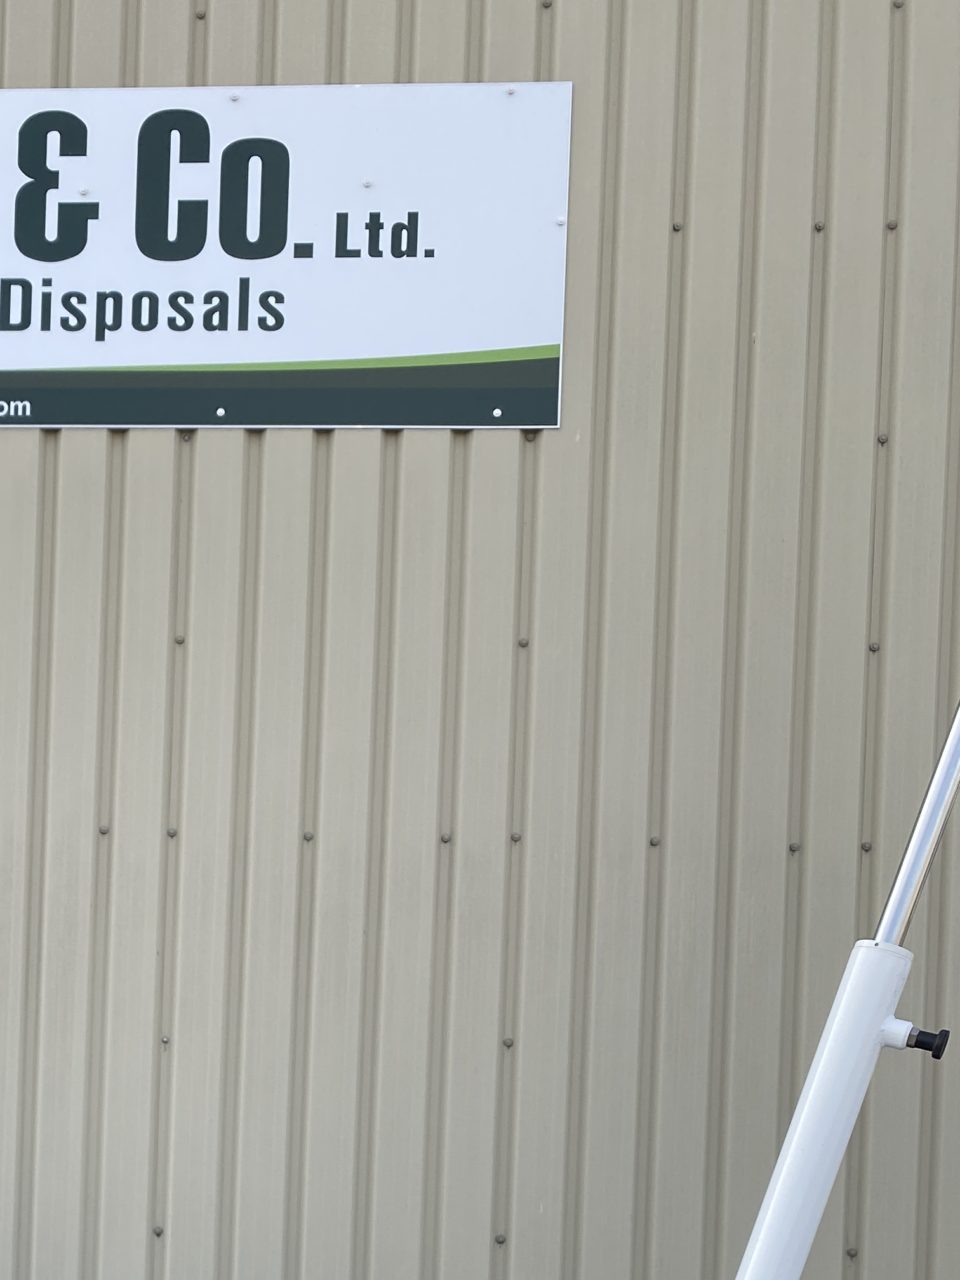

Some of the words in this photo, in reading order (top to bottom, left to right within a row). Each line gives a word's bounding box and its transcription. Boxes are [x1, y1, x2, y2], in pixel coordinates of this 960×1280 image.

[13, 110, 100, 263] &
[134, 108, 314, 262] Co.
[334, 211, 435, 259] Ltd.
